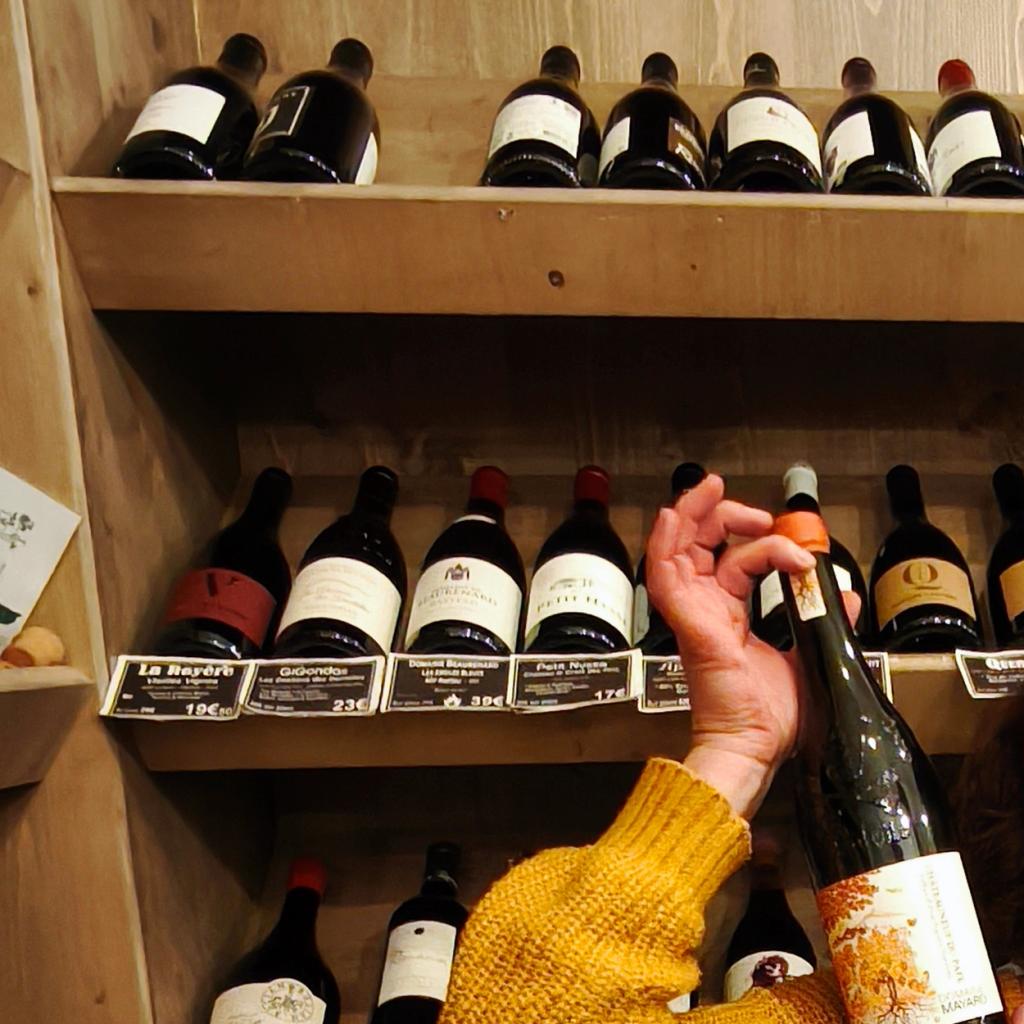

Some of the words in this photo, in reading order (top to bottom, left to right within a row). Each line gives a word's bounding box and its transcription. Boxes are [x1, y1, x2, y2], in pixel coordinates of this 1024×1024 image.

[138, 663, 161, 677] La
[593, 687, 626, 701] 17€
[332, 699, 369, 712] 23€
[940, 995, 988, 1016] MAYARD
